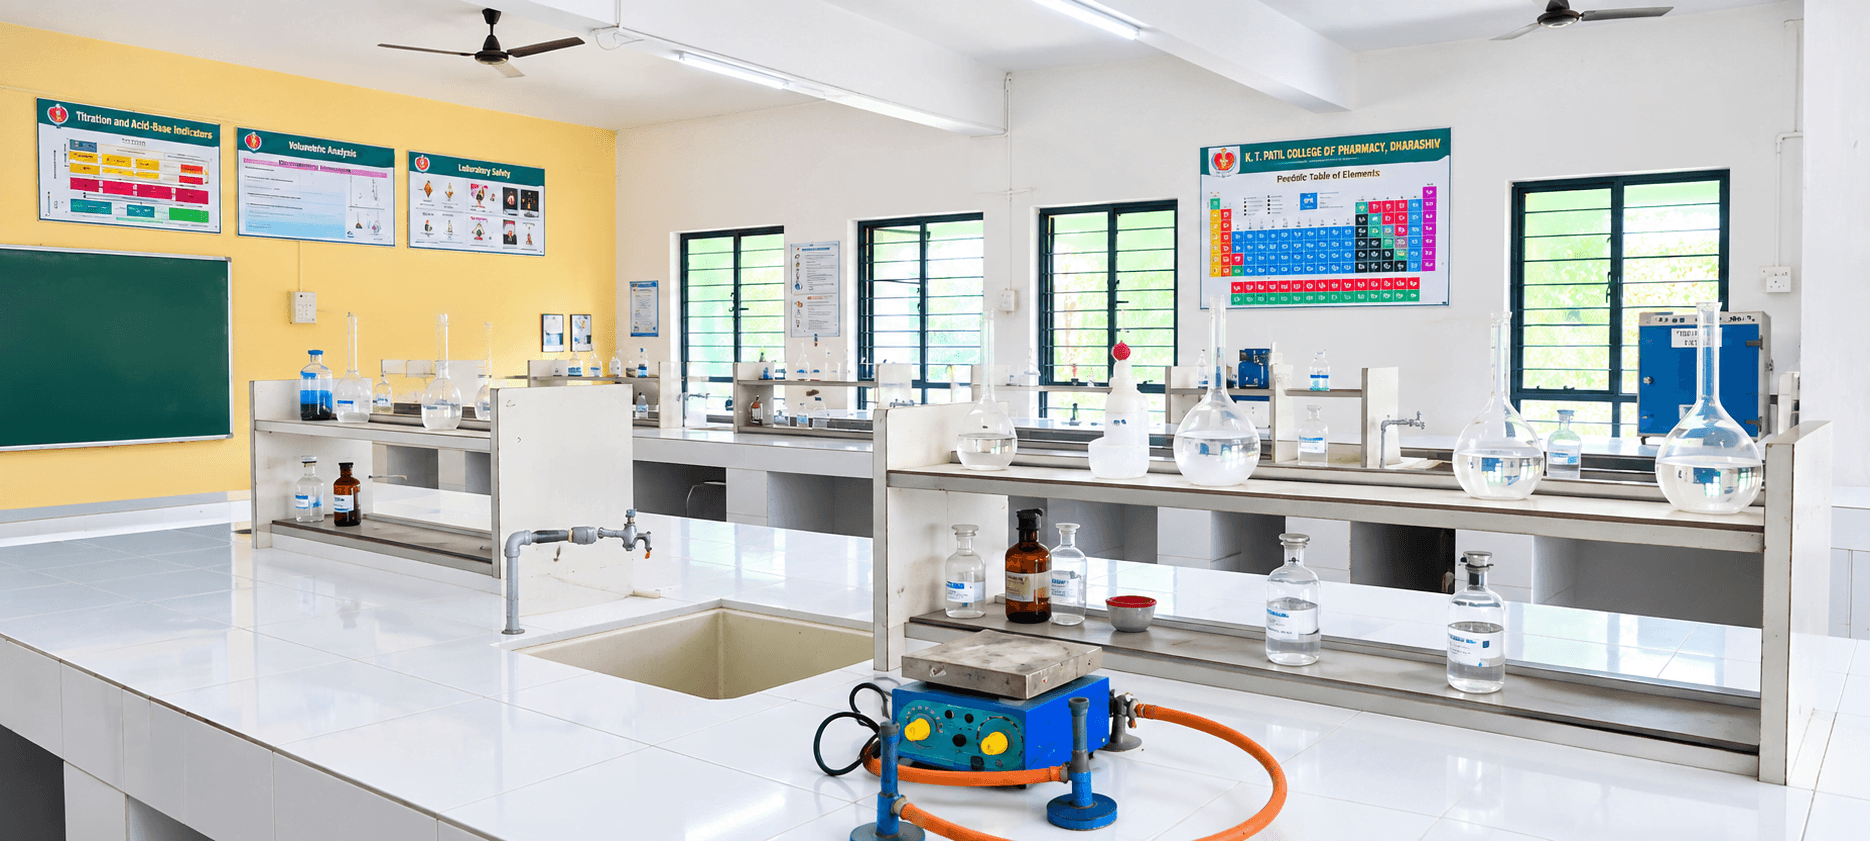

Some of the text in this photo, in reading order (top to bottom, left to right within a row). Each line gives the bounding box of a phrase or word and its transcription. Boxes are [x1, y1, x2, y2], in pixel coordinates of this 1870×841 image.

[76, 111, 112, 125] Titration
[114, 118, 130, 127] and
[1245, 152, 1254, 163] K.
[1255, 151, 1262, 162] T.
[1263, 149, 1285, 161] PATIL
[1287, 146, 1322, 159] COLLEGE
[1324, 145, 1336, 156] OF
[1338, 142, 1388, 155] PHARMACY,
[1390, 138, 1441, 152] DHARASHIV
[1309, 171, 1331, 181] Table
[1332, 170, 1341, 180] of
[1342, 169, 1381, 179] Elements
